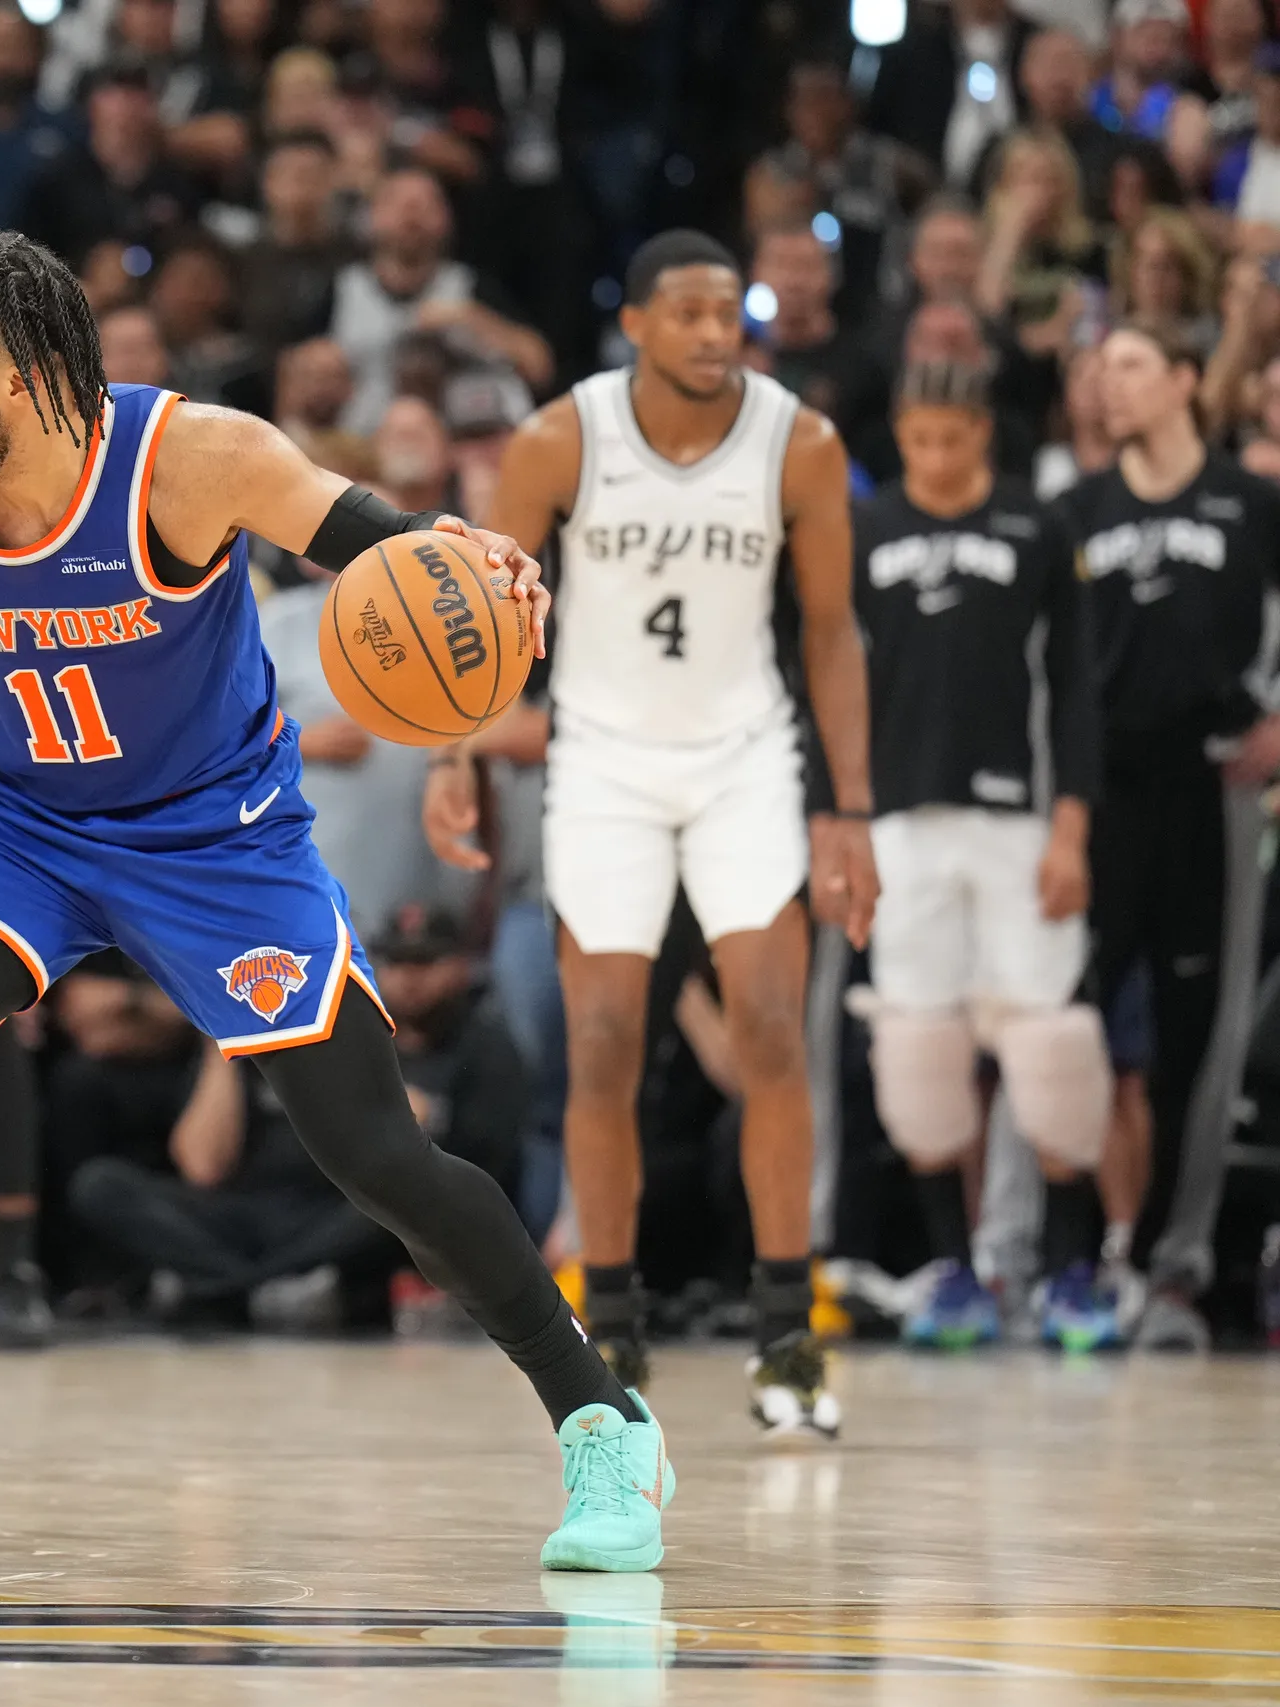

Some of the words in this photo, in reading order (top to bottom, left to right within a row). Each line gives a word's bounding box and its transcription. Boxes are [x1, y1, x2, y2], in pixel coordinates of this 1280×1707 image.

[61, 555, 96, 564] experience
[61, 563, 87, 574] abu
[89, 559, 127, 573] dhabi
[584, 523, 767, 576] SPURS
[19, 595, 163, 651] YORK
[359, 598, 407, 656] Finals
[411, 543, 488, 679] Wilson
[644, 596, 685, 660] 4
[4, 664, 123, 763] 11
[229, 952, 305, 993] KNICKS
[246, 951, 260, 961] NEW
[260, 948, 279, 958] YORK
